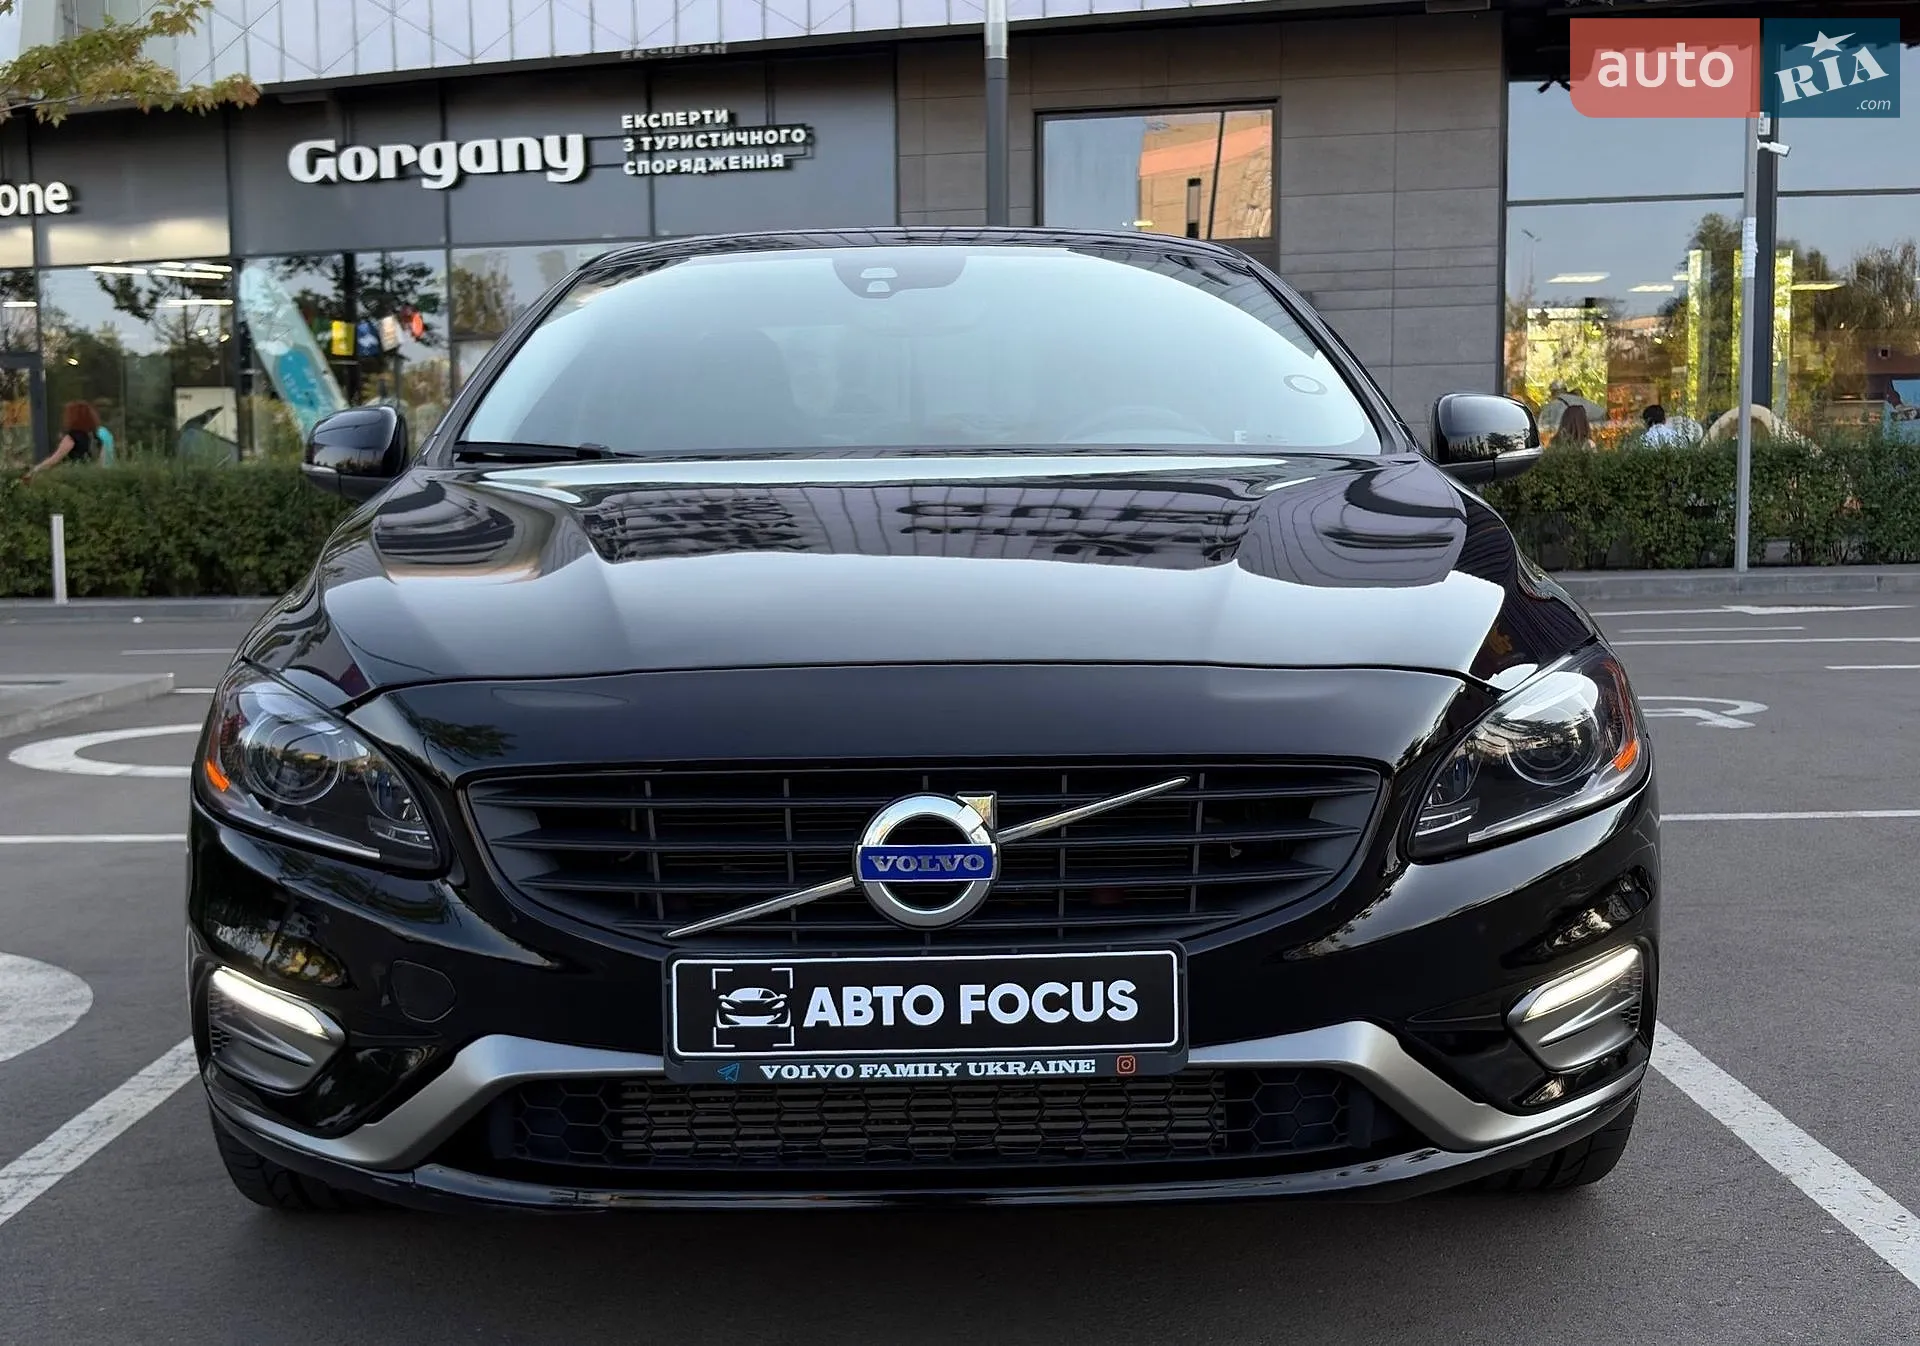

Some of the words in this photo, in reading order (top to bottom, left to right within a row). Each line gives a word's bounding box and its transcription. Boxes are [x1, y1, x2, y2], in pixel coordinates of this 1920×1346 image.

[620, 108, 730, 129] ЕКСПЕРТИ
[640, 128, 806, 151] ТУРИСТИЧНОГО
[288, 133, 585, 189] Gorgany
[623, 153, 785, 175] СПОРЯДЖЕННЯ
[868, 854, 985, 872] VOLVO
[802, 984, 945, 1028] АВТО
[960, 980, 1139, 1025] FOCUS
[759, 1064, 854, 1081] VOLVO
[859, 1062, 962, 1079] FAMILY
[967, 1058, 1096, 1077] UKRAINE
